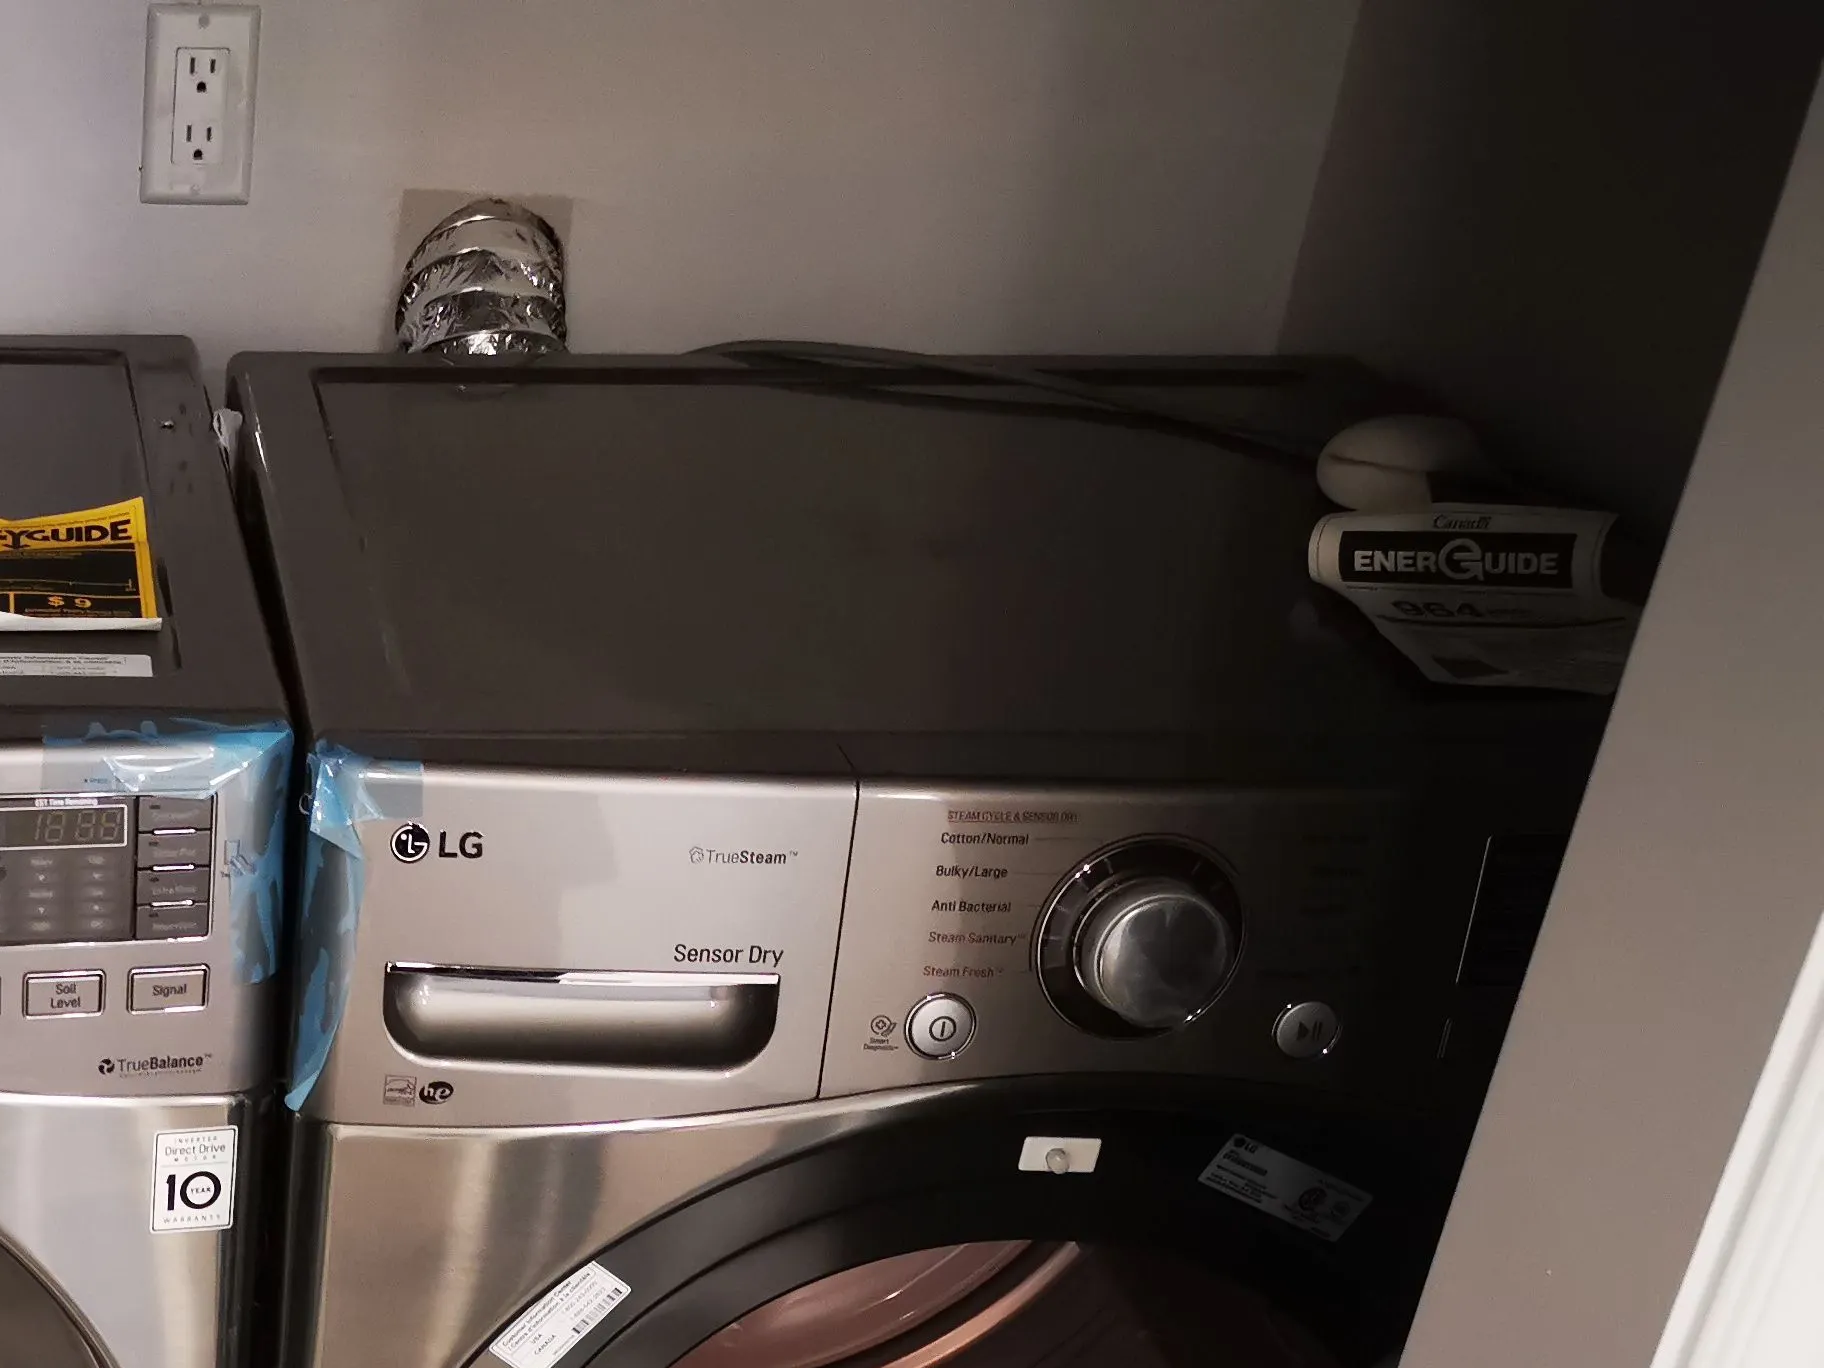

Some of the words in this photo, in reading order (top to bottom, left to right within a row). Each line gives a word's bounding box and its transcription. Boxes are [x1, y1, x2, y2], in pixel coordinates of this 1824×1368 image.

[1353, 537, 1560, 581] ENERGUIDE
[438, 829, 484, 860] LG
[940, 832, 1029, 845] Cotton/Normal
[935, 865, 1008, 879] Bulky/Large
[931, 900, 956, 912] Anti
[958, 901, 1012, 913] Bacterial
[928, 931, 965, 943] Steam
[674, 943, 743, 964] Sensor
[748, 944, 784, 967] Dry
[922, 965, 960, 977] Steam
[55, 981, 77, 995] Soil
[152, 983, 187, 998] Signal
[50, 996, 81, 1009] Level
[165, 1145, 196, 1156] Direct
[199, 1143, 226, 1154] Drive
[166, 1170, 222, 1211] 10
